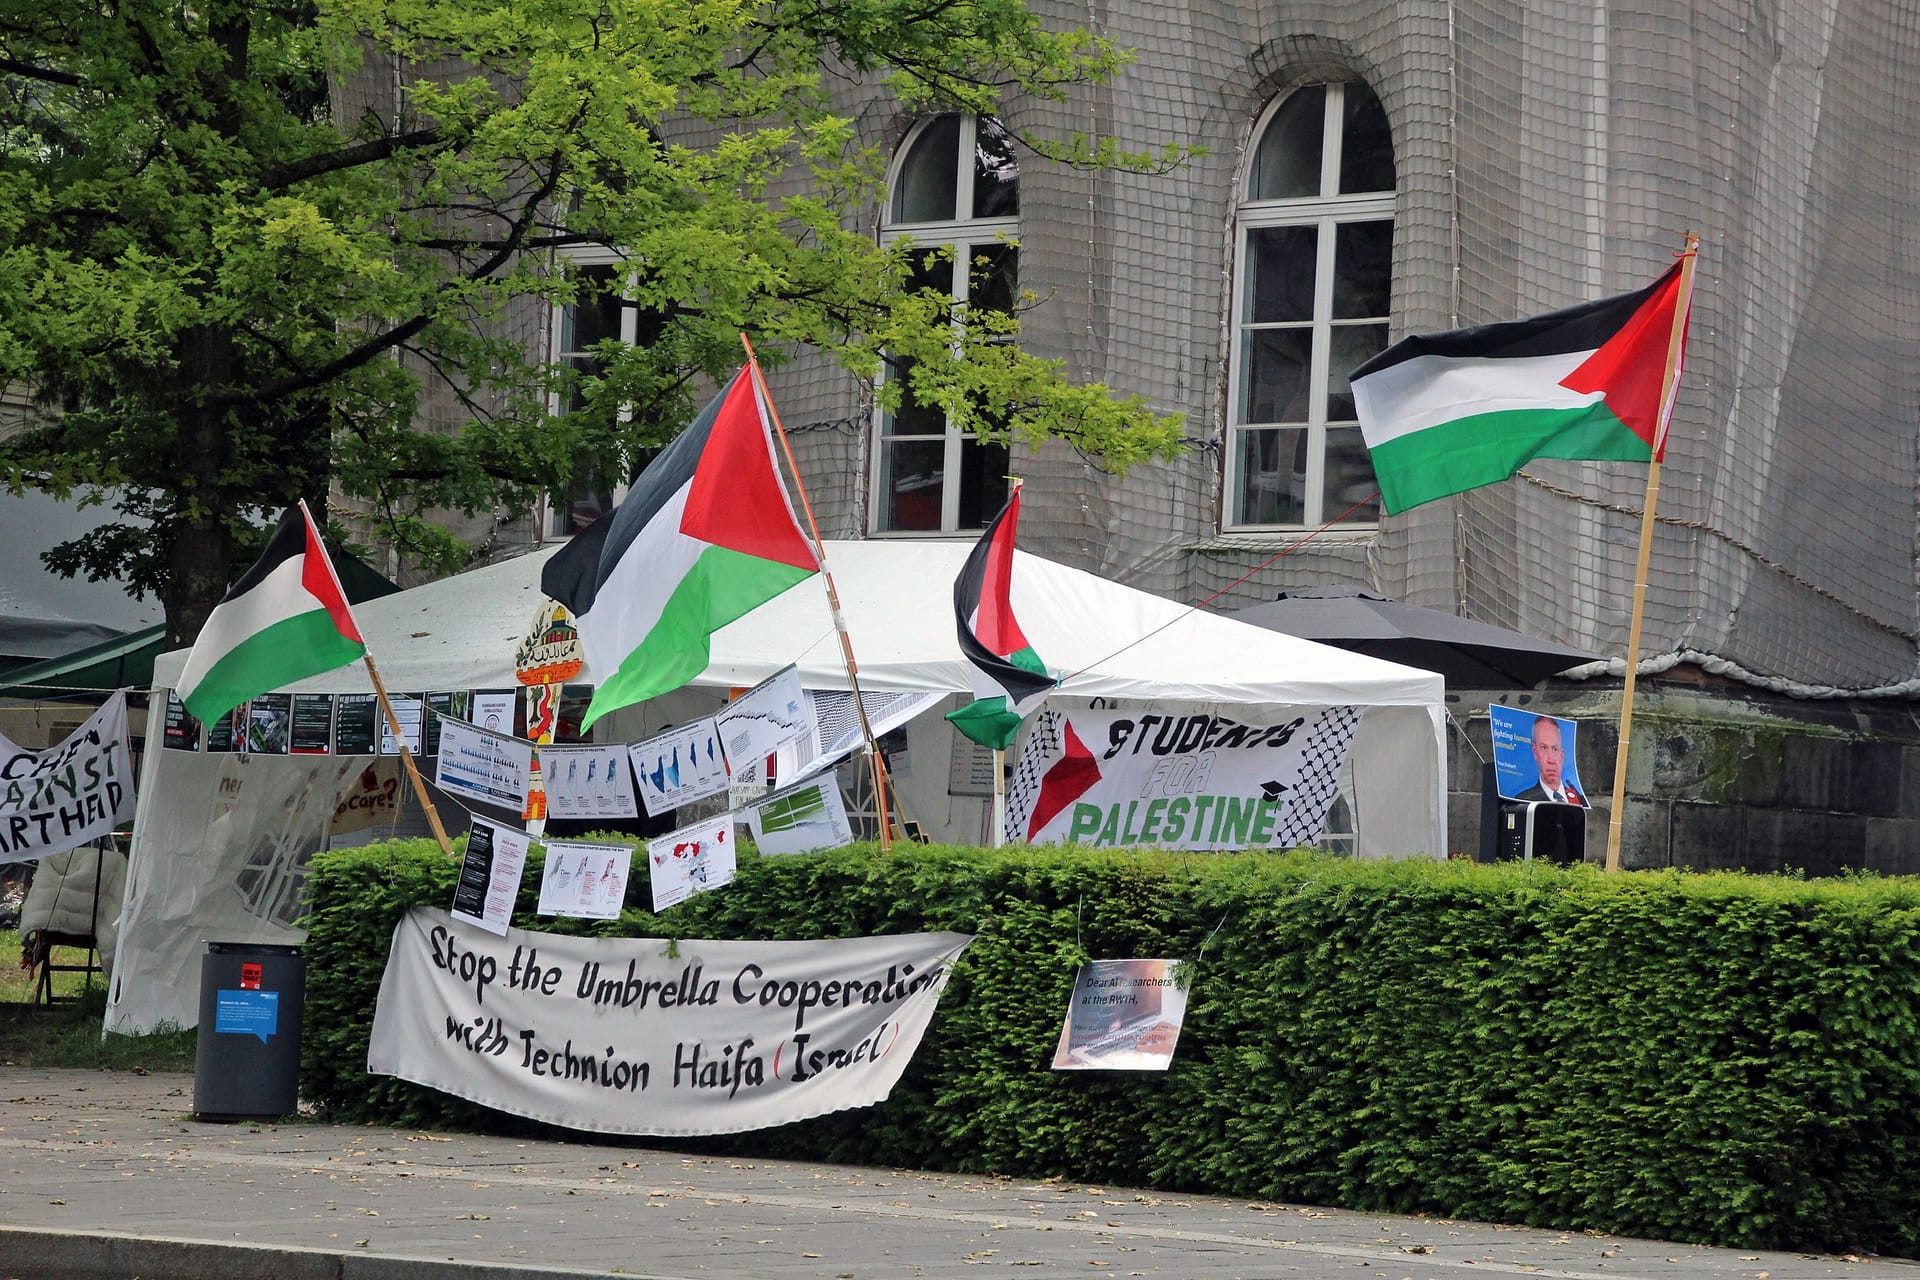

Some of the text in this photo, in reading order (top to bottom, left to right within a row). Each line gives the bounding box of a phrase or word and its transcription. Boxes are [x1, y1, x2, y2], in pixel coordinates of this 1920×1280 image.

[1103, 715, 1304, 760] STUDENTS
[348, 778, 397, 811] care?
[1069, 795, 1283, 847] PALESTINE
[431, 925, 945, 1033] Stop the Umbrella Cooperation
[1081, 994, 1138, 1007] at the RWTH,
[1086, 978, 1108, 988] Dear
[1119, 976, 1173, 988] researchers
[446, 1015, 509, 1057] with
[519, 1029, 650, 1093] Technion
[673, 1038, 764, 1100] Haifa
